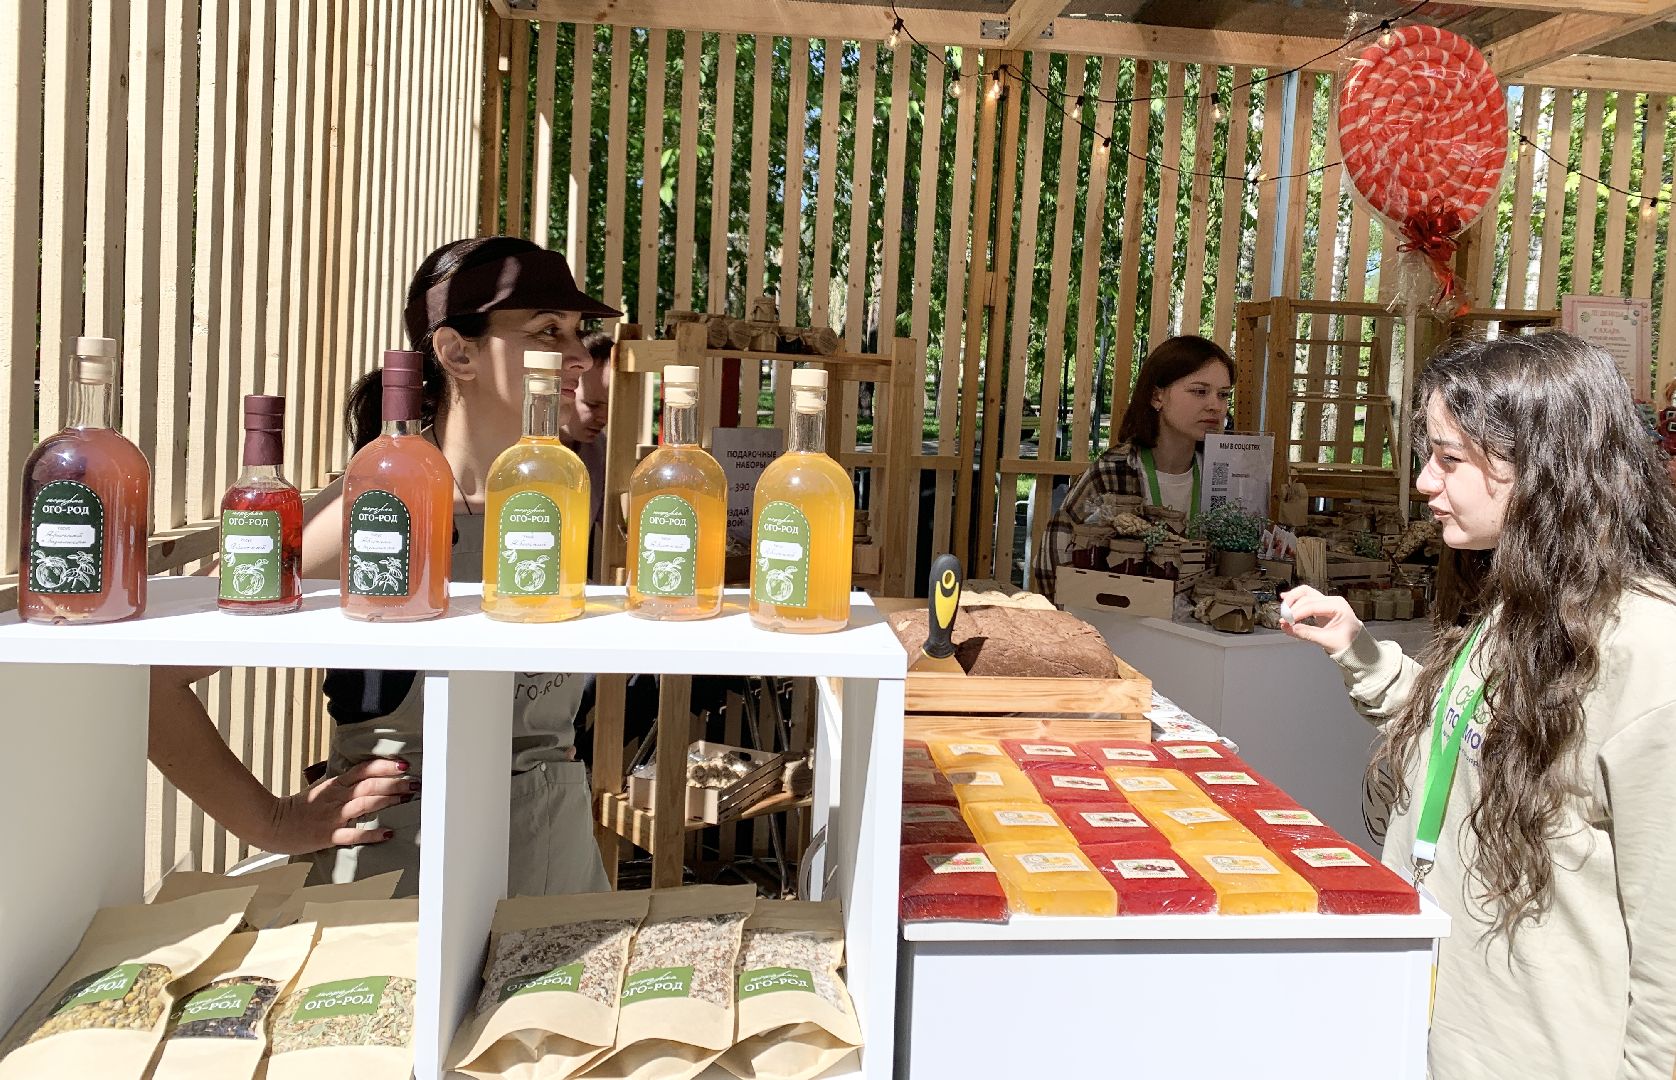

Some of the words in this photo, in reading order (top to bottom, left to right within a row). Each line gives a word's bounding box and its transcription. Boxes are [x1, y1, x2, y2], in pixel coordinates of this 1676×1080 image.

[726, 450, 777, 459] ПОДАРОЧНЫЕ
[735, 461, 767, 469] НАБОРЫ
[42, 505, 90, 516] ОГО-РОД
[727, 506, 750, 517] ЗДАЙ
[228, 517, 269, 527] ОГО-РОД
[358, 513, 398, 524] ОГО-РОД
[509, 514, 550, 523] ОГО-РОД
[649, 516, 687, 527] ОГО-РОД
[727, 517, 743, 528] ВОЙ
[763, 523, 799, 536] ОГО-РОД
[620, 982, 683, 999] ОГО-РОД
[744, 978, 809, 992] ОГО-РОД
[304, 993, 375, 1011] ОГО-РОД
